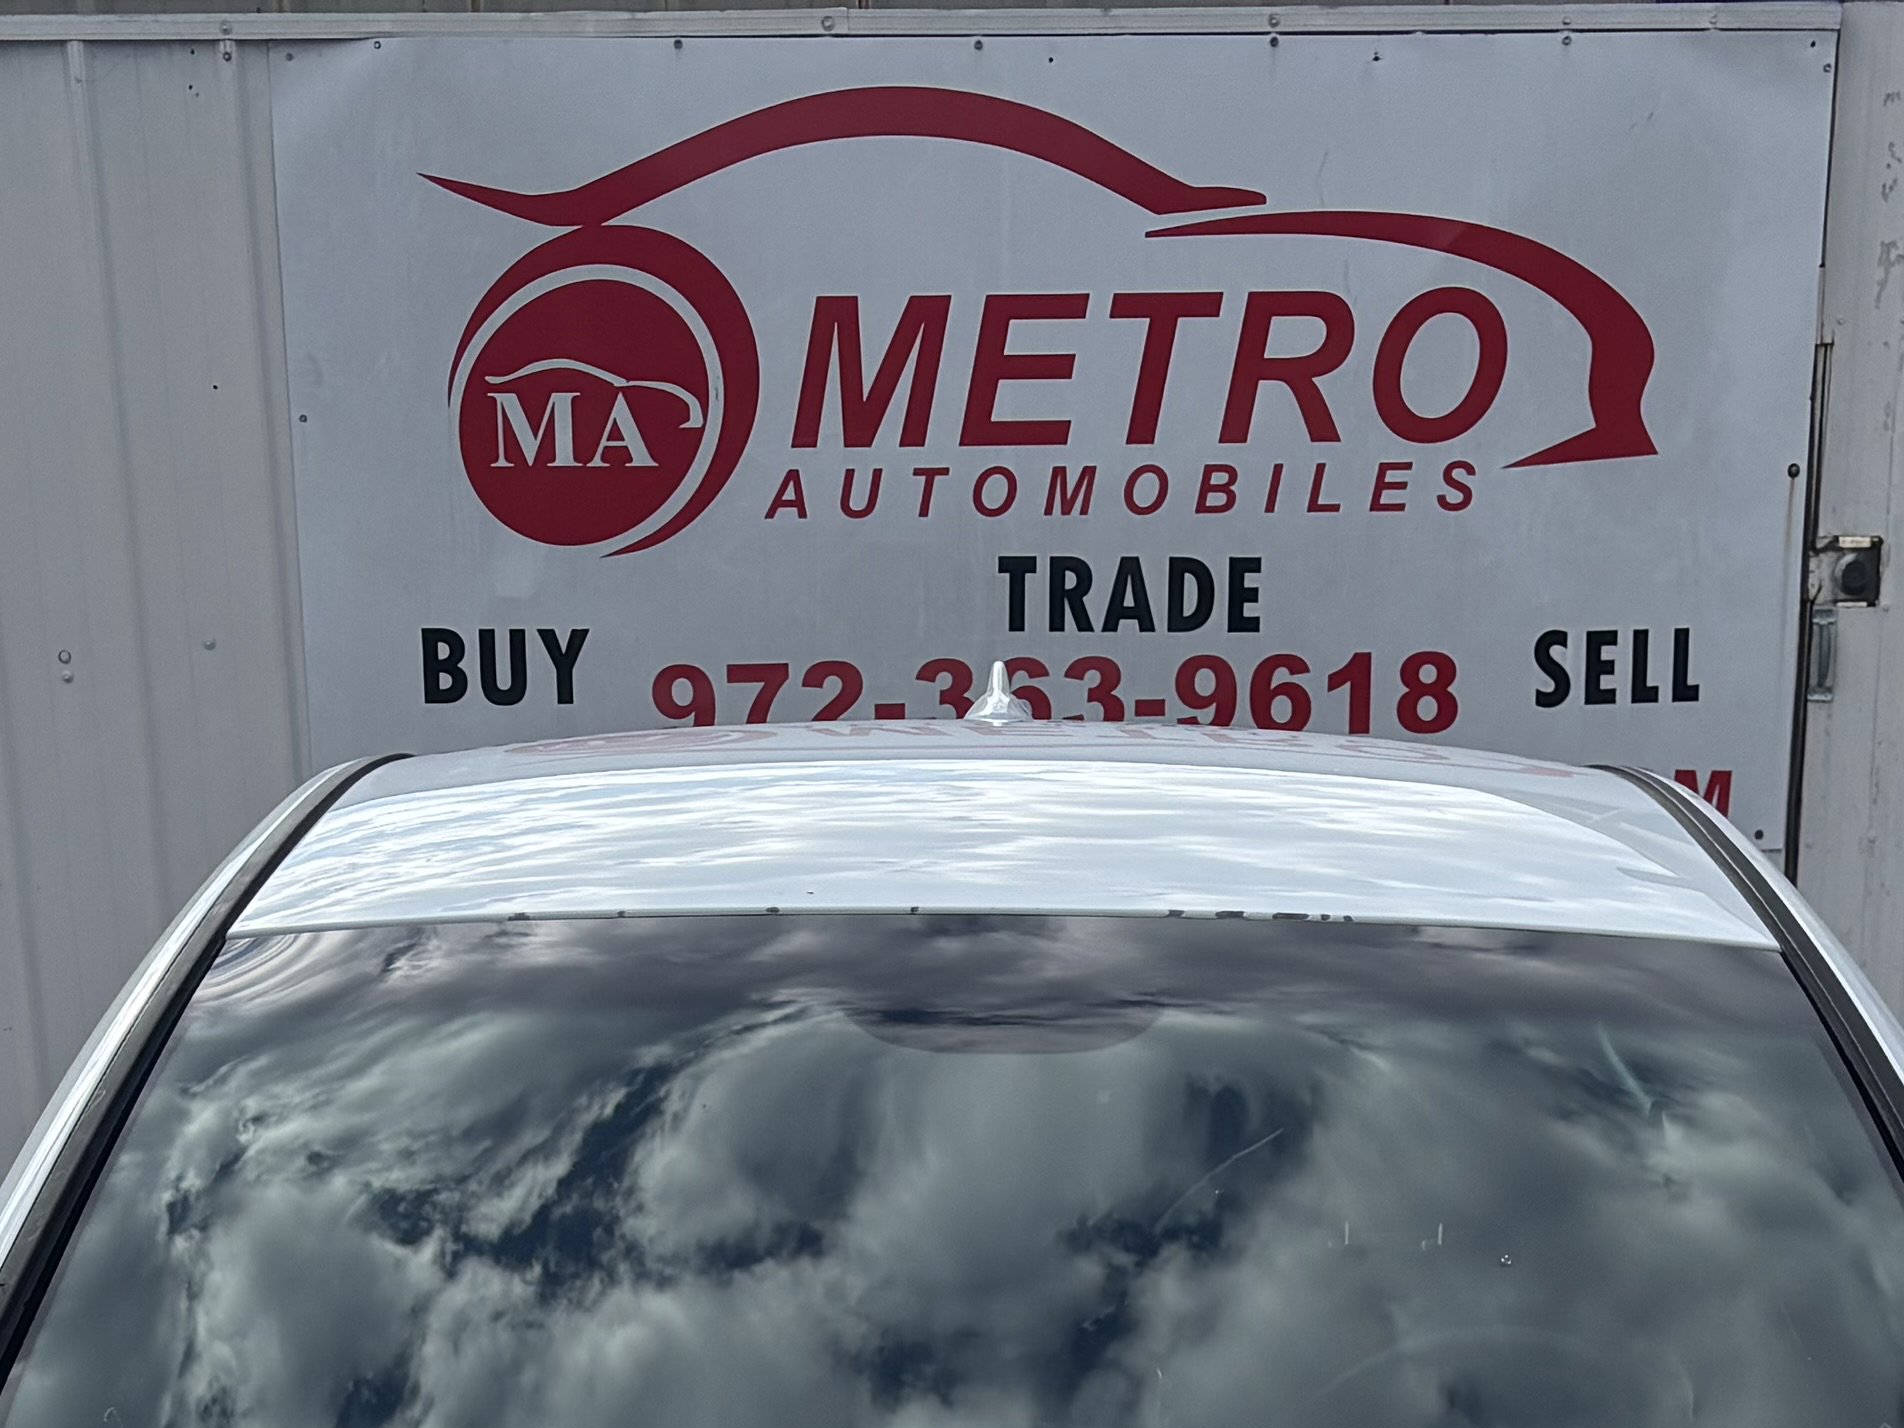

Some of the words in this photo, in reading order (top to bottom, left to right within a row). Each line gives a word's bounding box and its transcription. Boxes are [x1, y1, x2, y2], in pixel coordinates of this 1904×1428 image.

[791, 286, 1509, 450] METRO
[487, 391, 659, 467] MA
[765, 461, 1479, 520] AUTOMOBILES
[997, 554, 1264, 635] TRADE
[421, 627, 591, 707] BUY
[1533, 627, 1701, 709] SELL
